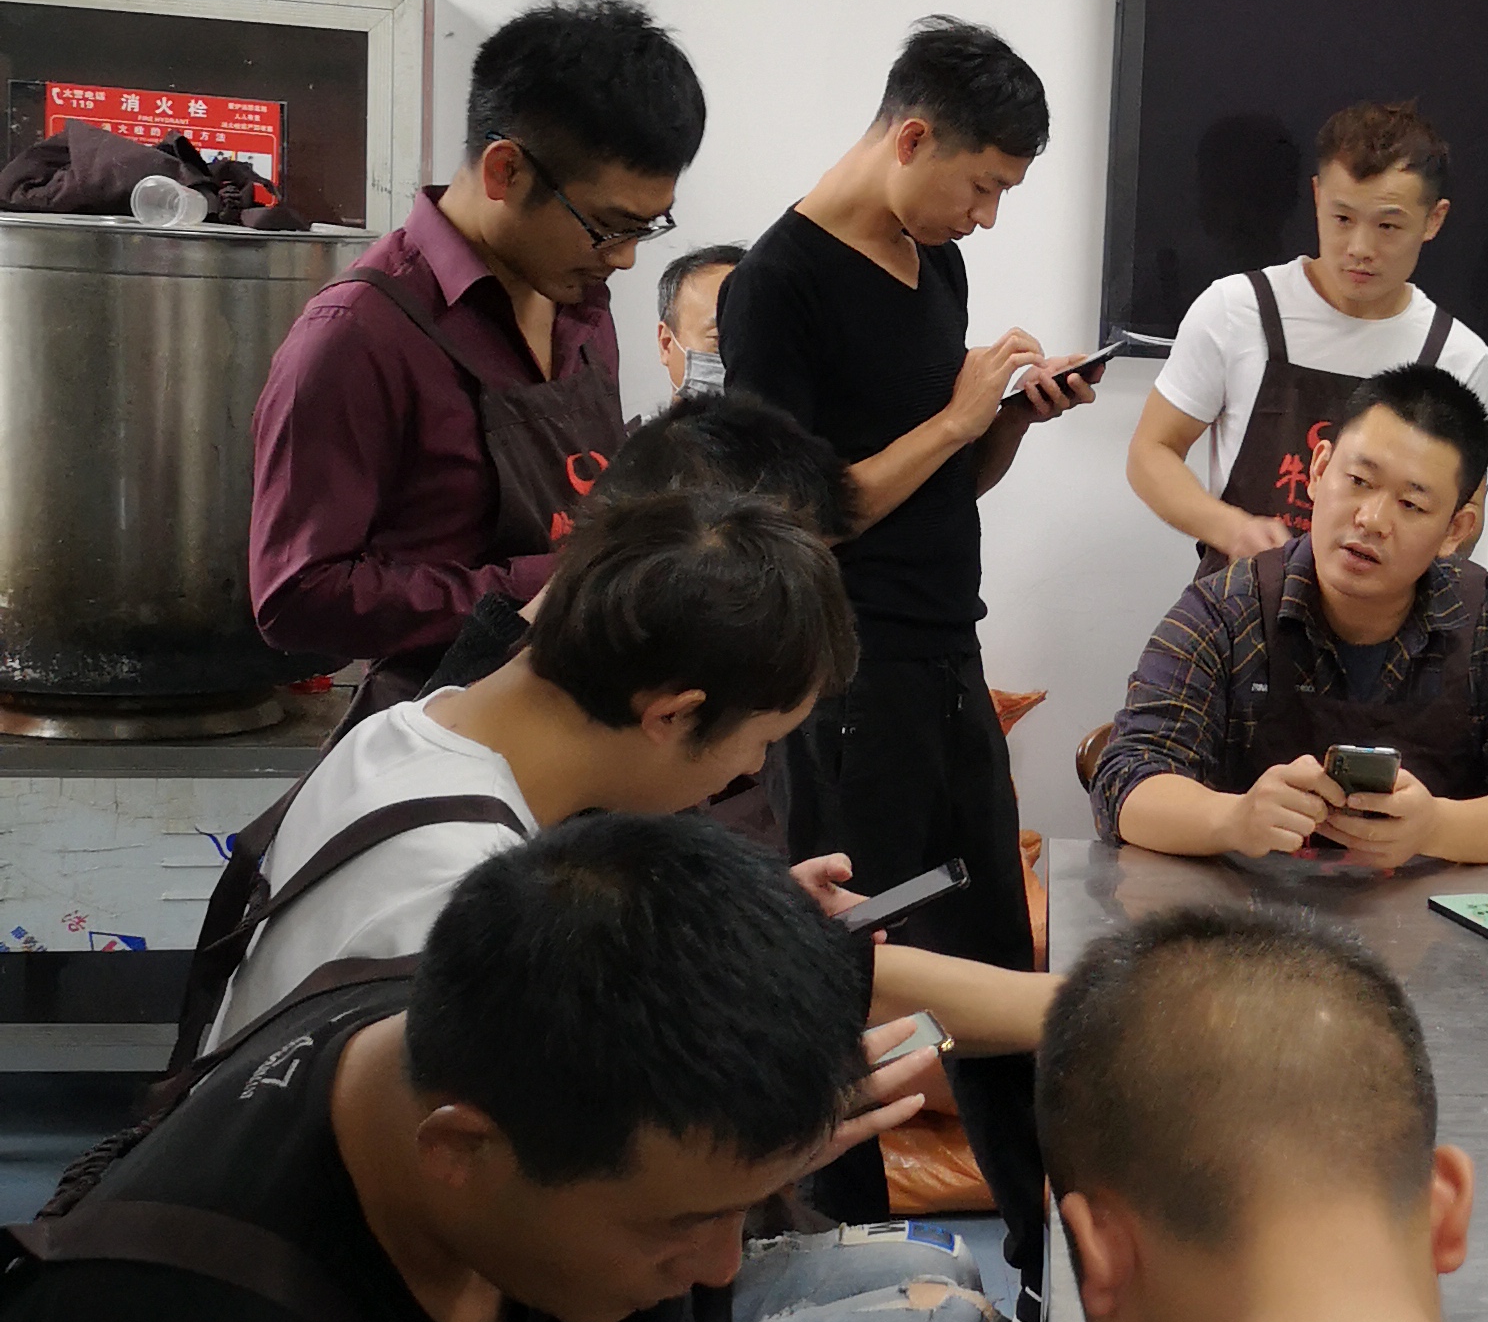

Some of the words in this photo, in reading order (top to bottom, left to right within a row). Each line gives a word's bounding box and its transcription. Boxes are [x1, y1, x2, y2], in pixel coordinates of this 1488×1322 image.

[71, 99, 95, 109] 119
[120, 93, 208, 118] 消火栓
[1275, 453, 1313, 510] 牛
